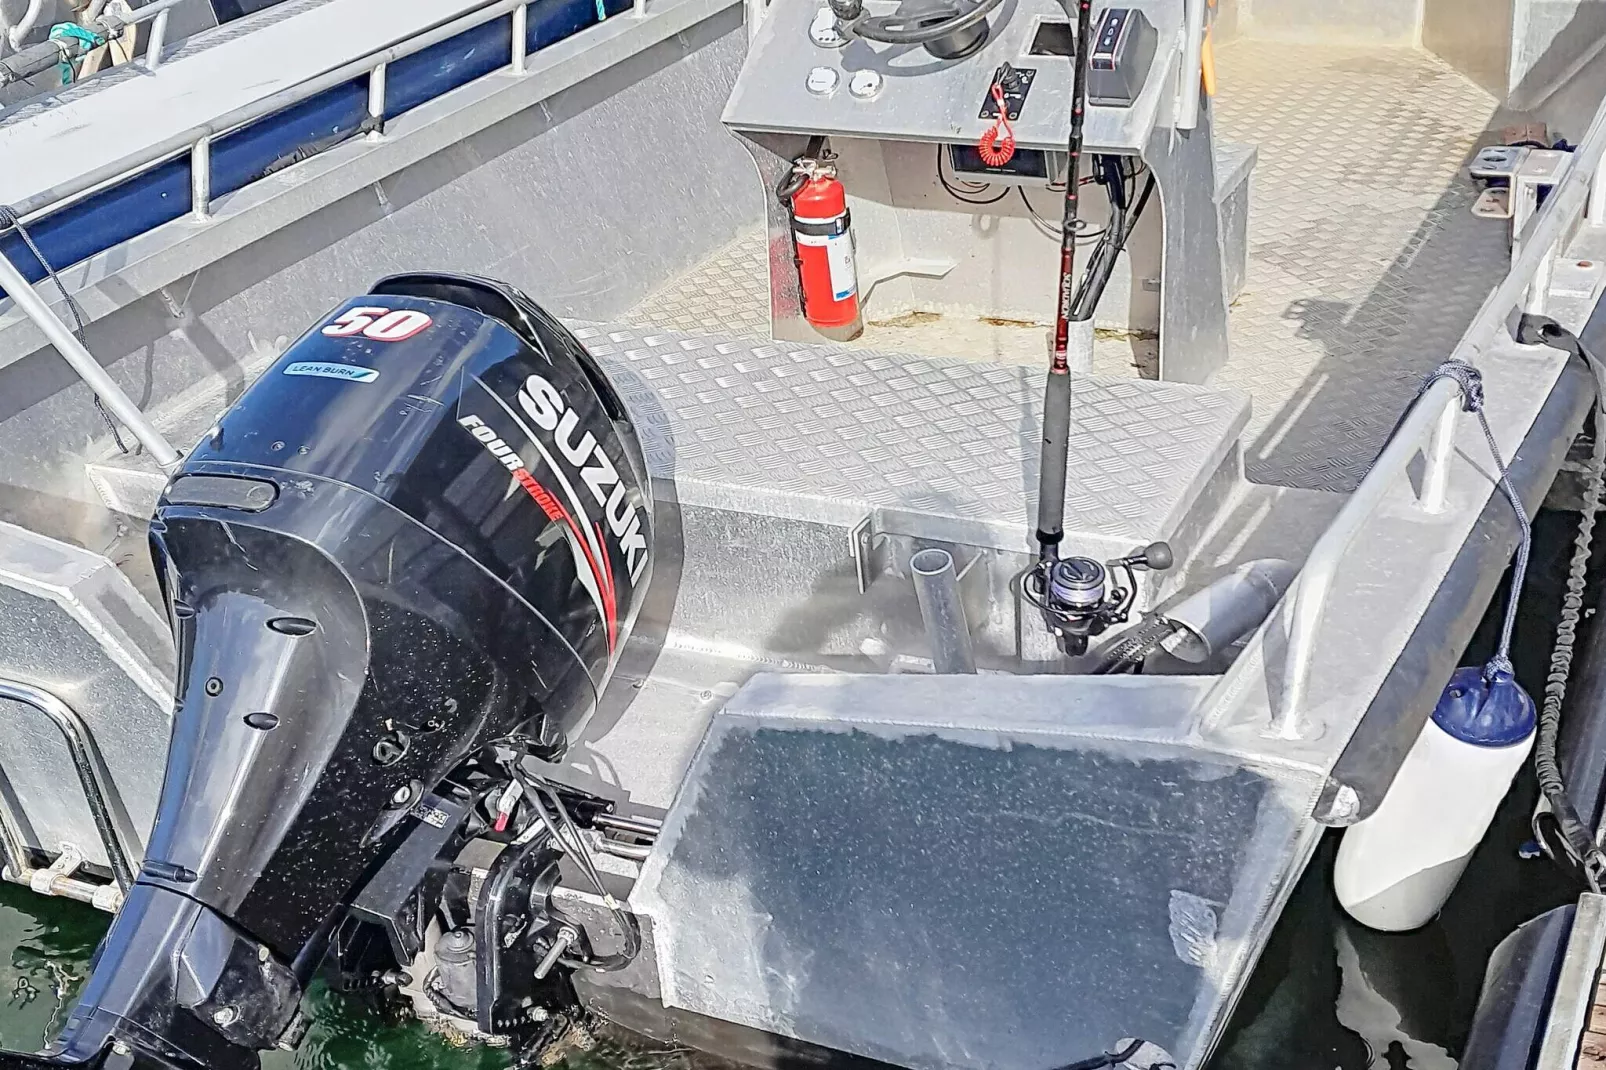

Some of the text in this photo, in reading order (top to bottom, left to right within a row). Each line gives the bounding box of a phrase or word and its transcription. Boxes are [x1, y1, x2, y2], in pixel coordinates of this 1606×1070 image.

[321, 306, 433, 342] 50
[292, 365, 355, 376] LEAN BURN
[518, 374, 649, 588] SUZUKI
